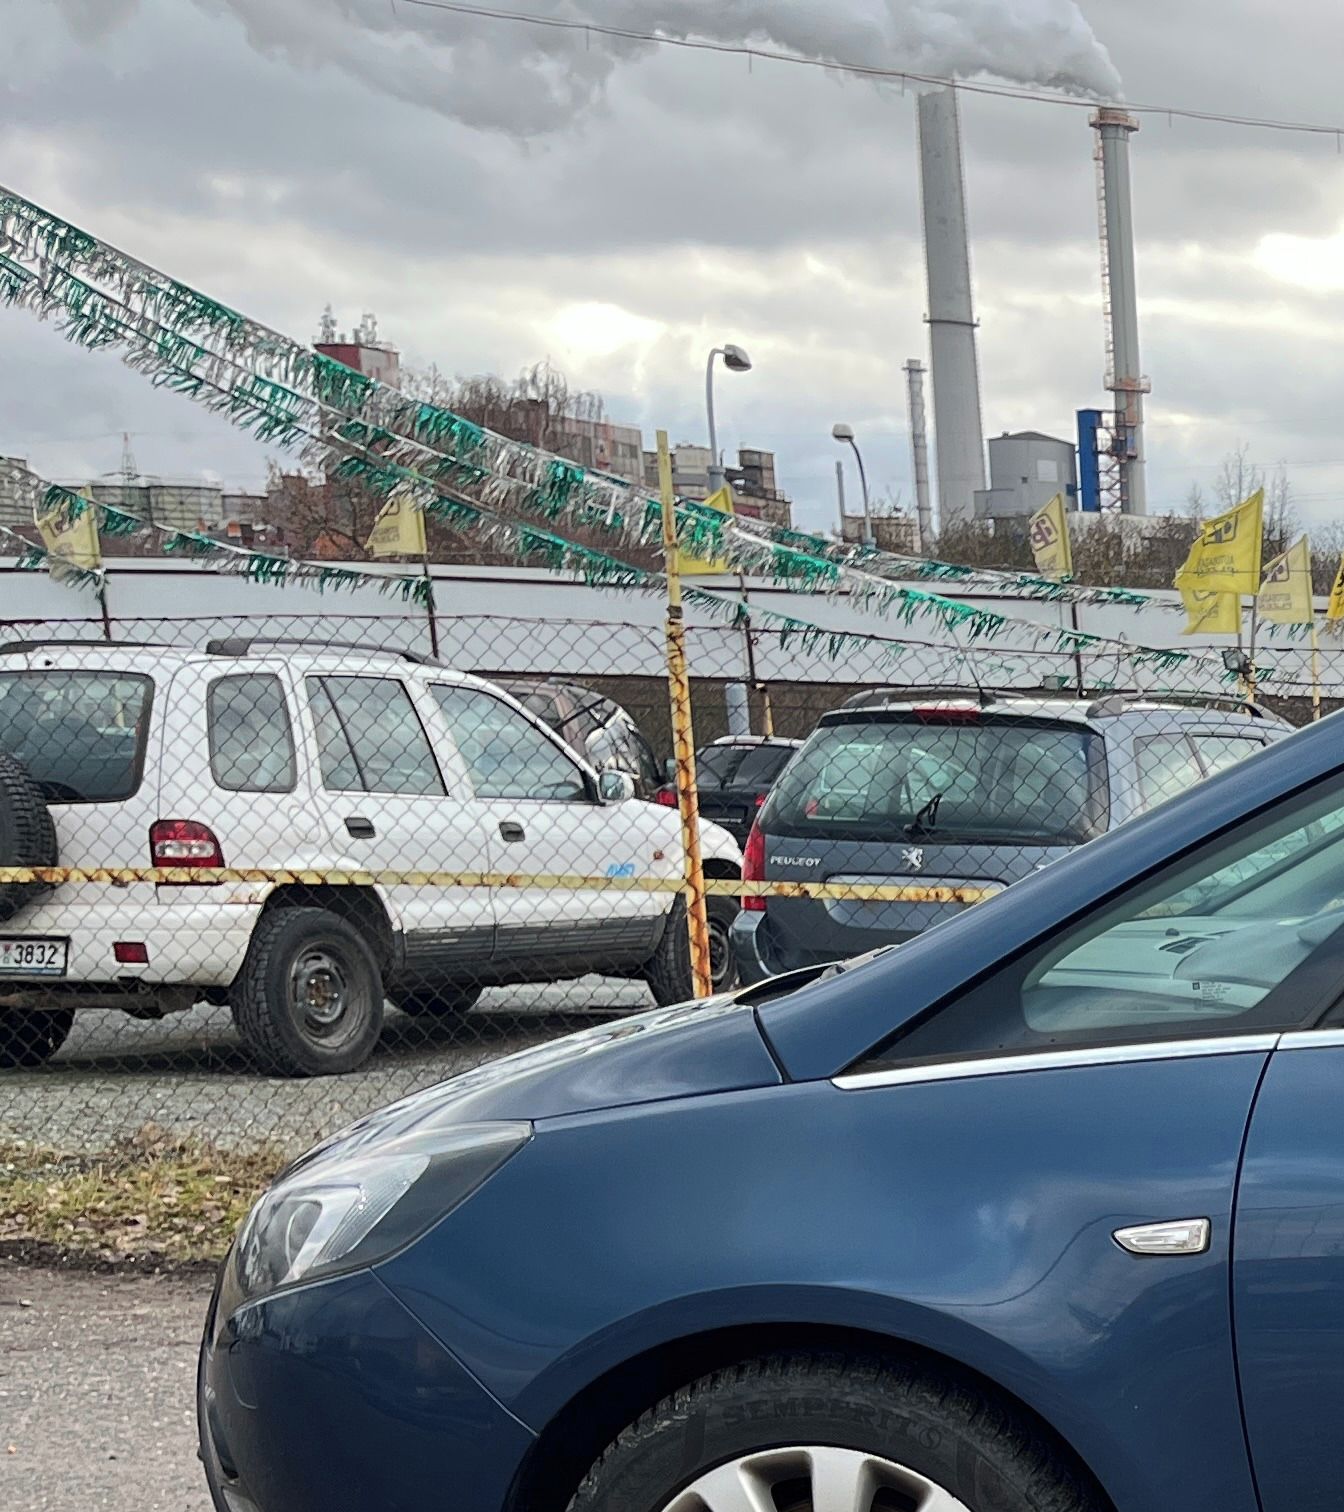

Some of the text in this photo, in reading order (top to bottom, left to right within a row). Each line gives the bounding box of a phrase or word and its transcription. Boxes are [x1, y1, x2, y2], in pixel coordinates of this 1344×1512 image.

[770, 855, 821, 867] PEUGEOT
[14, 944, 58, 965] 3832
[722, 1396, 916, 1437] SEMPERIT
